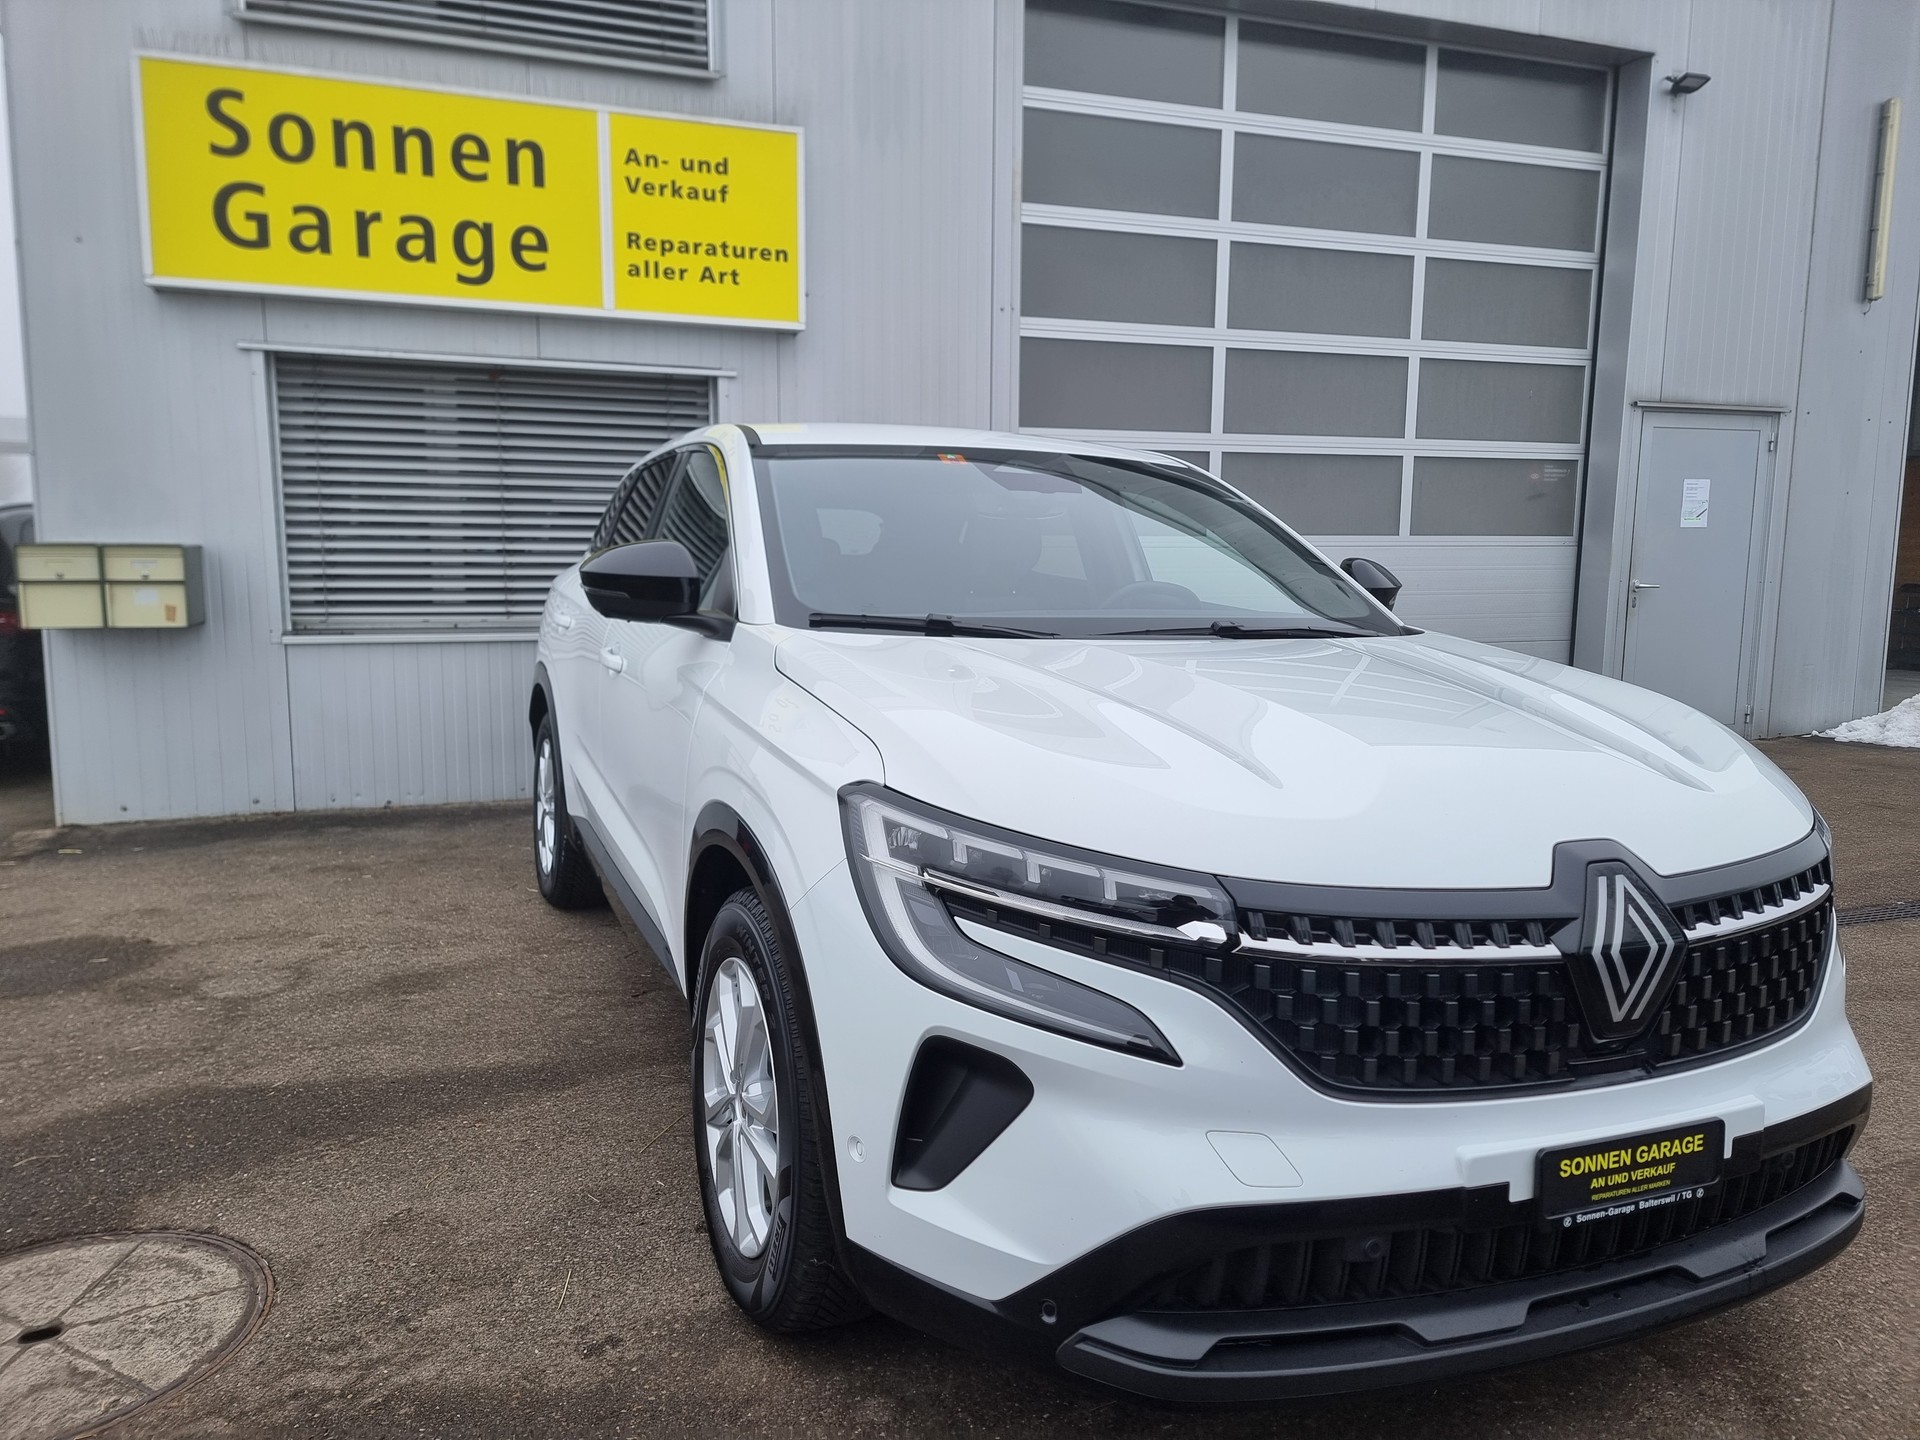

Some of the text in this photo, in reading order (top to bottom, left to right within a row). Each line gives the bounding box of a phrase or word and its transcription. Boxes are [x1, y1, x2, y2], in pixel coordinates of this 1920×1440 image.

[205, 88, 546, 189] Sonnen
[624, 148, 729, 176] An- und
[625, 176, 729, 203] Verkauf
[212, 181, 549, 286] Garage
[627, 231, 788, 263] Reparaturen
[627, 259, 739, 286] aller Art
[736, 922, 771, 1001] WINTER
[1559, 1133, 1705, 1178] SONNEN GARAGE
[1590, 1162, 1676, 1189] AN UND VERKAUF
[1591, 1179, 1671, 1201] REPARATUREN ALLER MARKEN
[1575, 1204, 1636, 1223] Sonnen-Garage
[1638, 1193, 1676, 1210] Balterswil
[1682, 1190, 1693, 1201] TG
